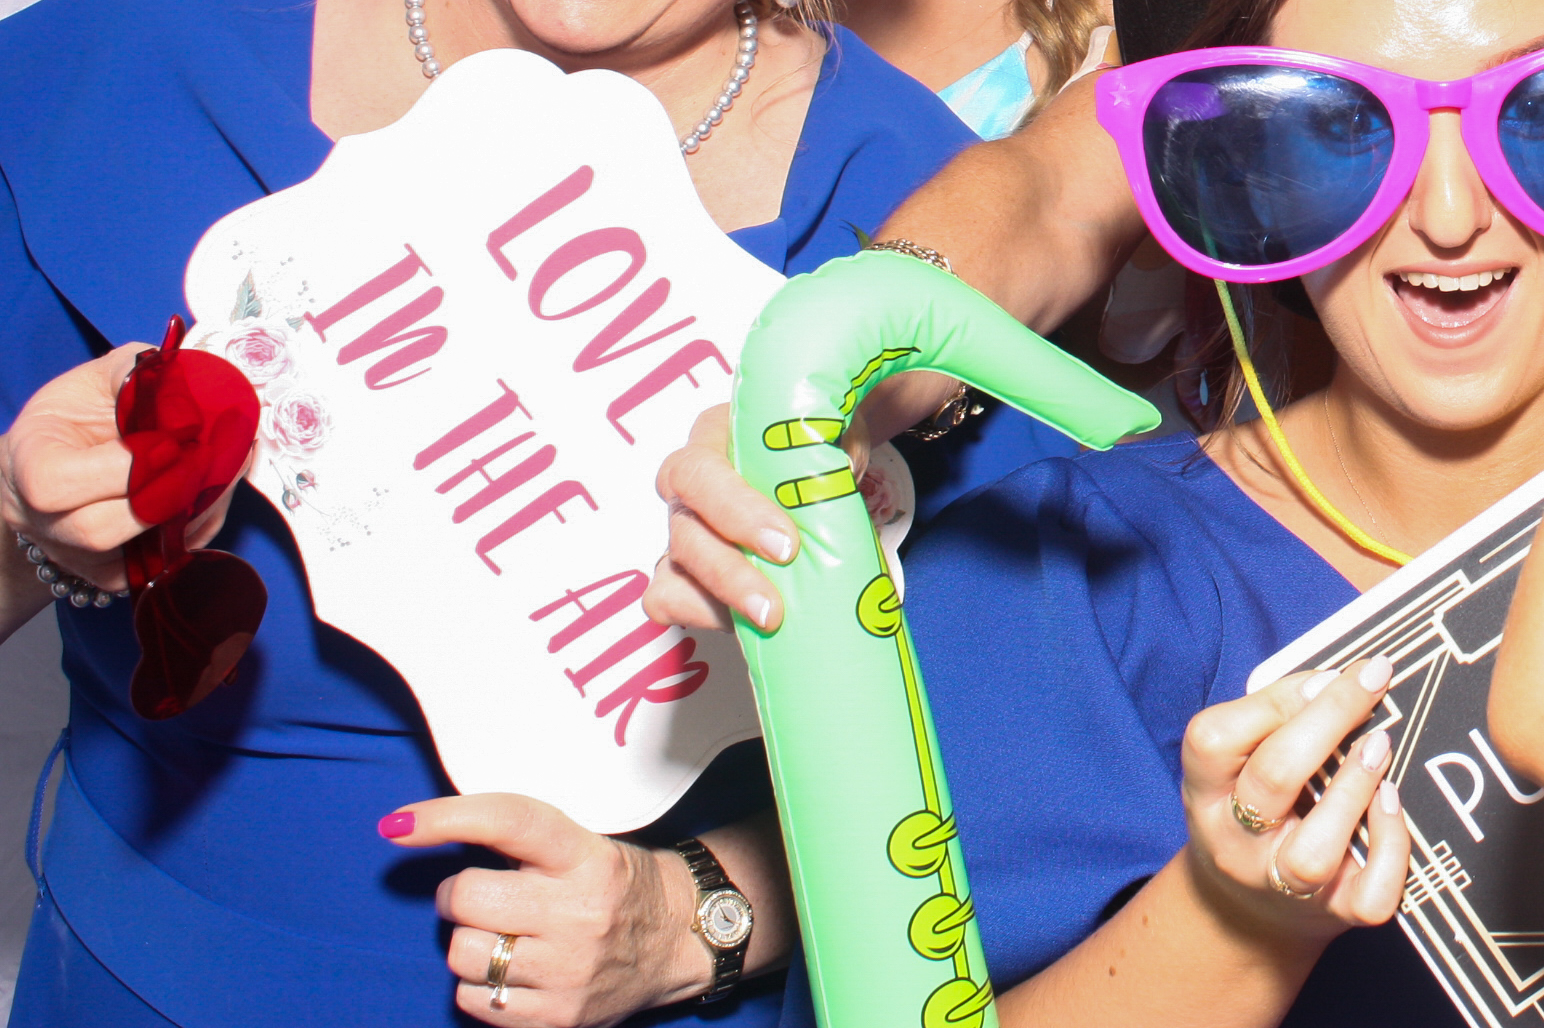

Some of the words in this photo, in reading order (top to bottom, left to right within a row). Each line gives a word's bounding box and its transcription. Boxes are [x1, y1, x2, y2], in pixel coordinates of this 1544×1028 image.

[486, 164, 733, 446] LOVE
[412, 377, 599, 576] THE
[528, 569, 710, 747] AIR
